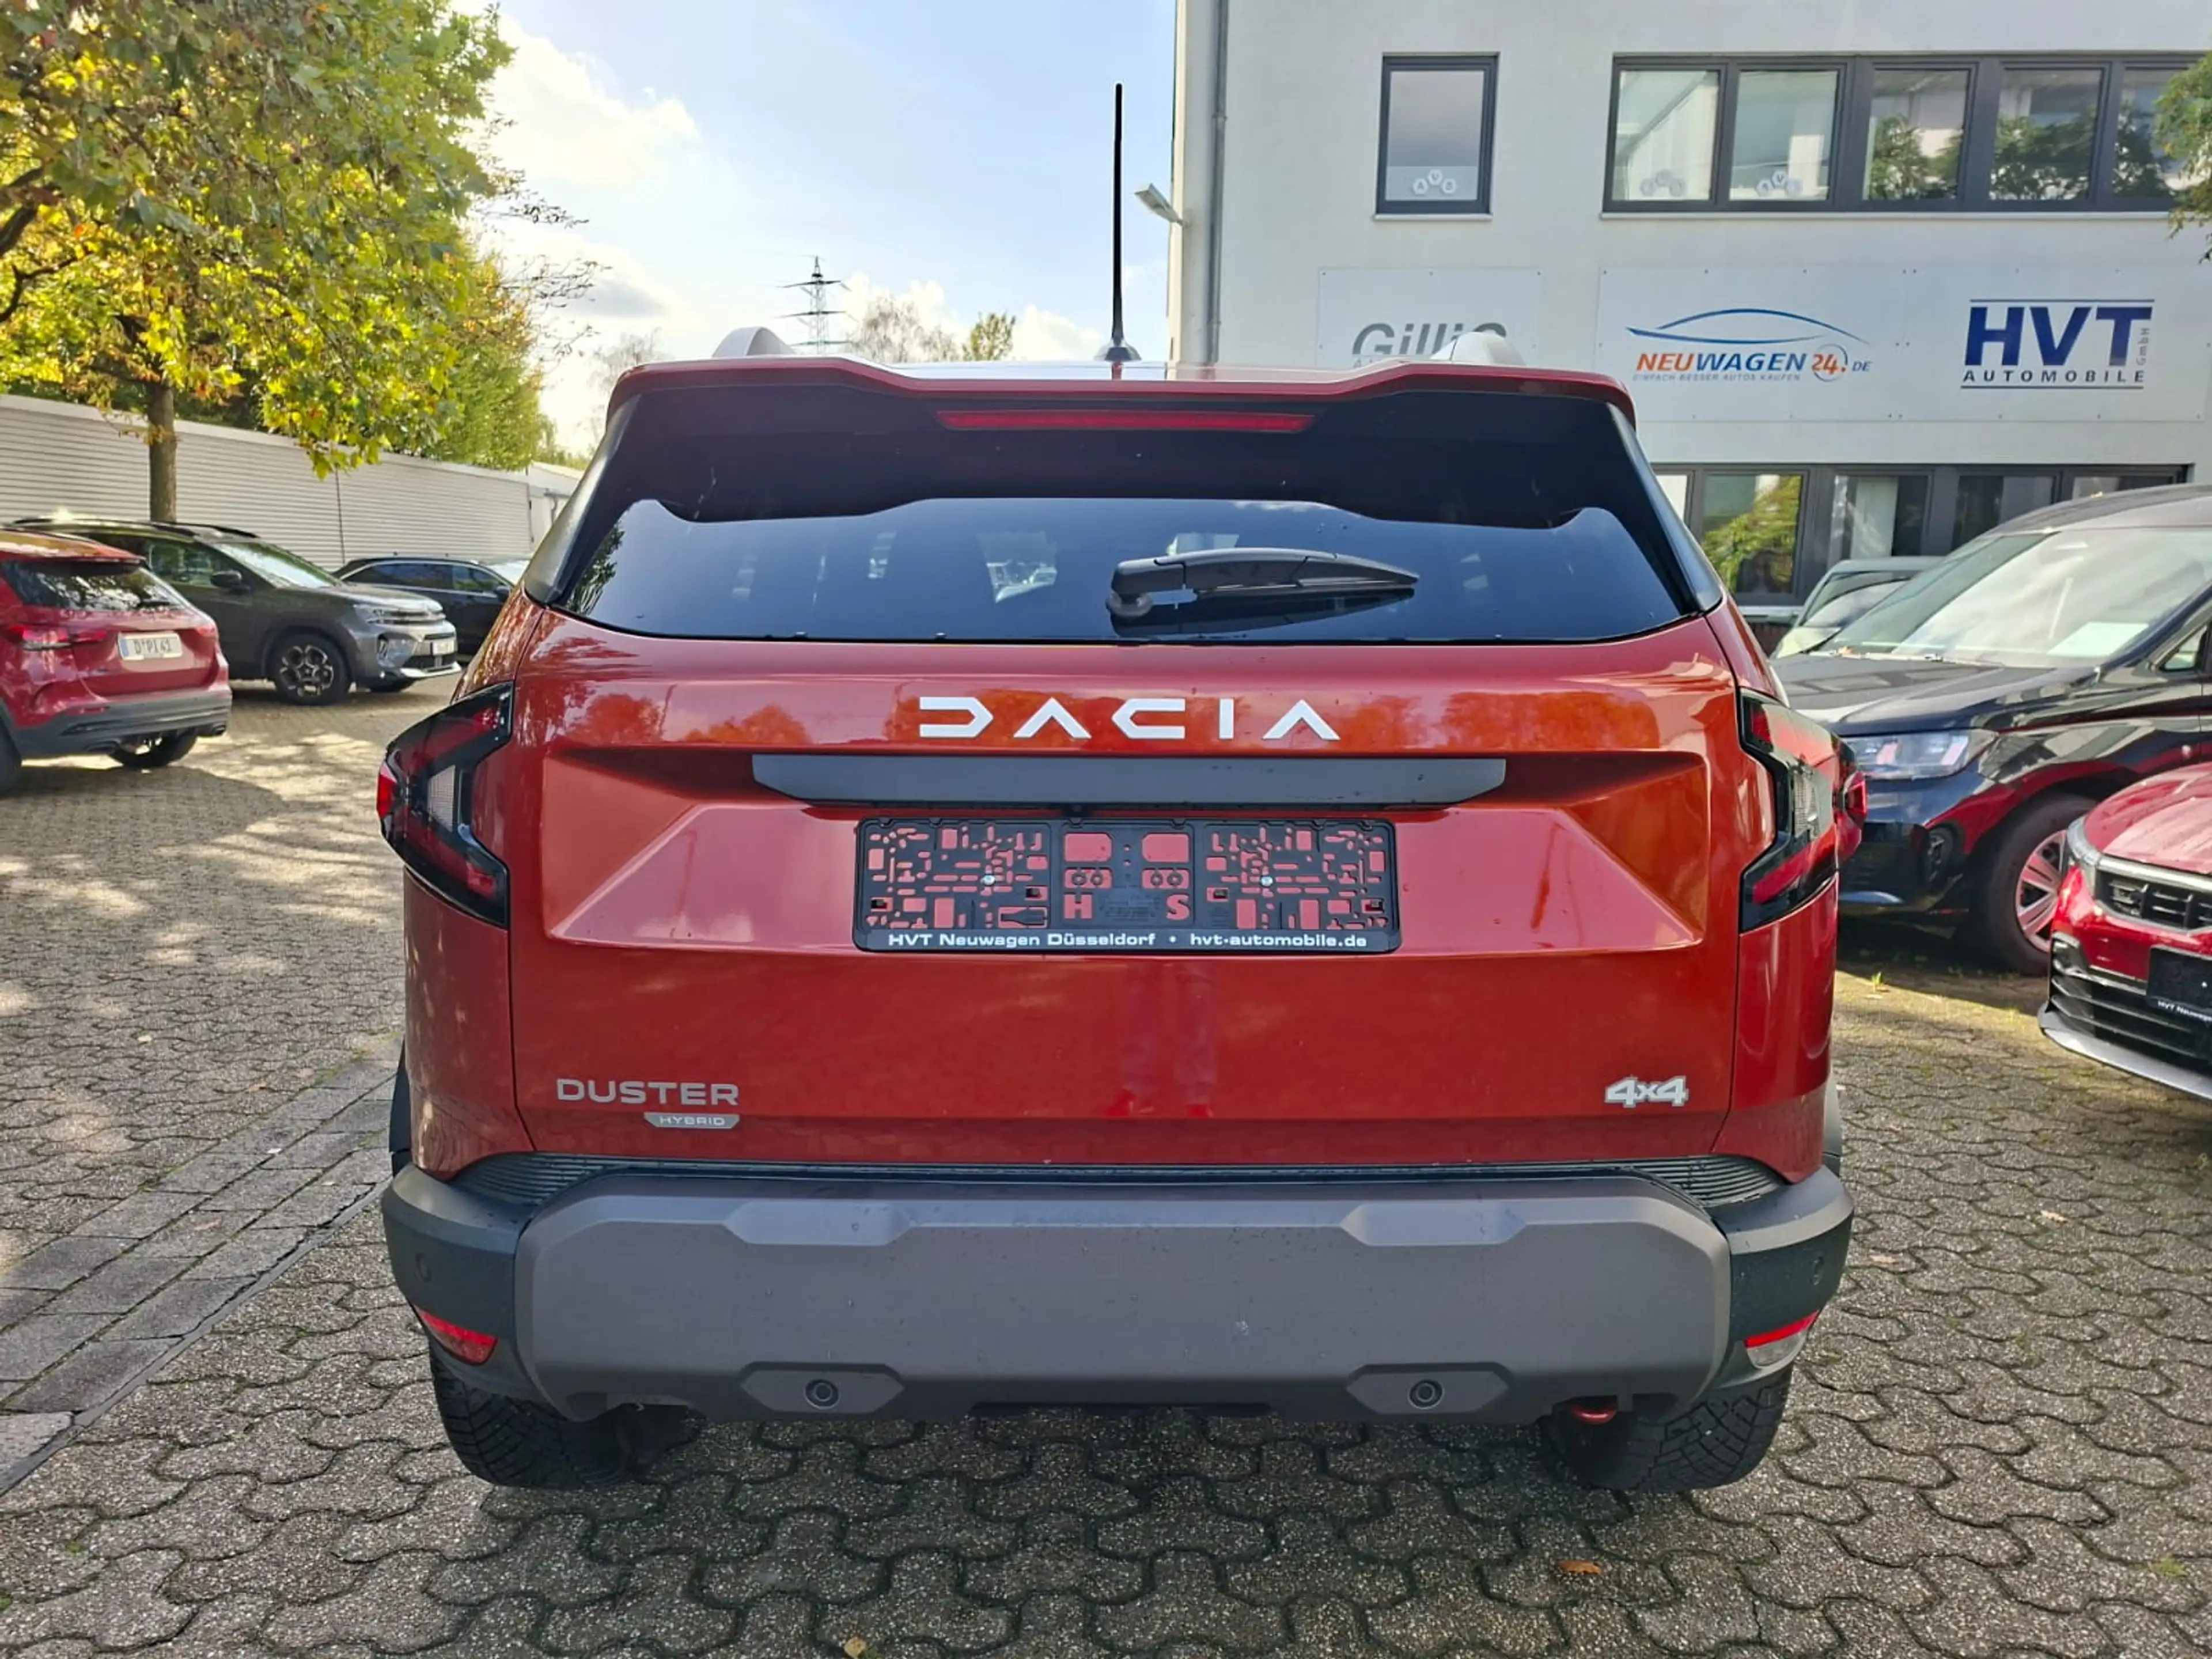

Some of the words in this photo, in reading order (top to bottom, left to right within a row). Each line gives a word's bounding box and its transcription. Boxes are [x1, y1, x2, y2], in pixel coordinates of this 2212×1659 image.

[1352, 323, 1506, 355] Gilli
[1965, 306, 2152, 365] HVT
[1963, 370, 2145, 382] AUTOMOBILE
[919, 696, 1341, 741] DACIA
[888, 933, 933, 946] HVT
[940, 933, 1040, 948] Neuwagen
[1047, 932, 1157, 946] Düsseldorf
[1190, 933, 1368, 948] hvt-automobile.de
[556, 1078, 740, 1106] DUSTER
[1605, 1075, 1689, 1108] 4x4
[659, 1116, 726, 1126] HYBRID
